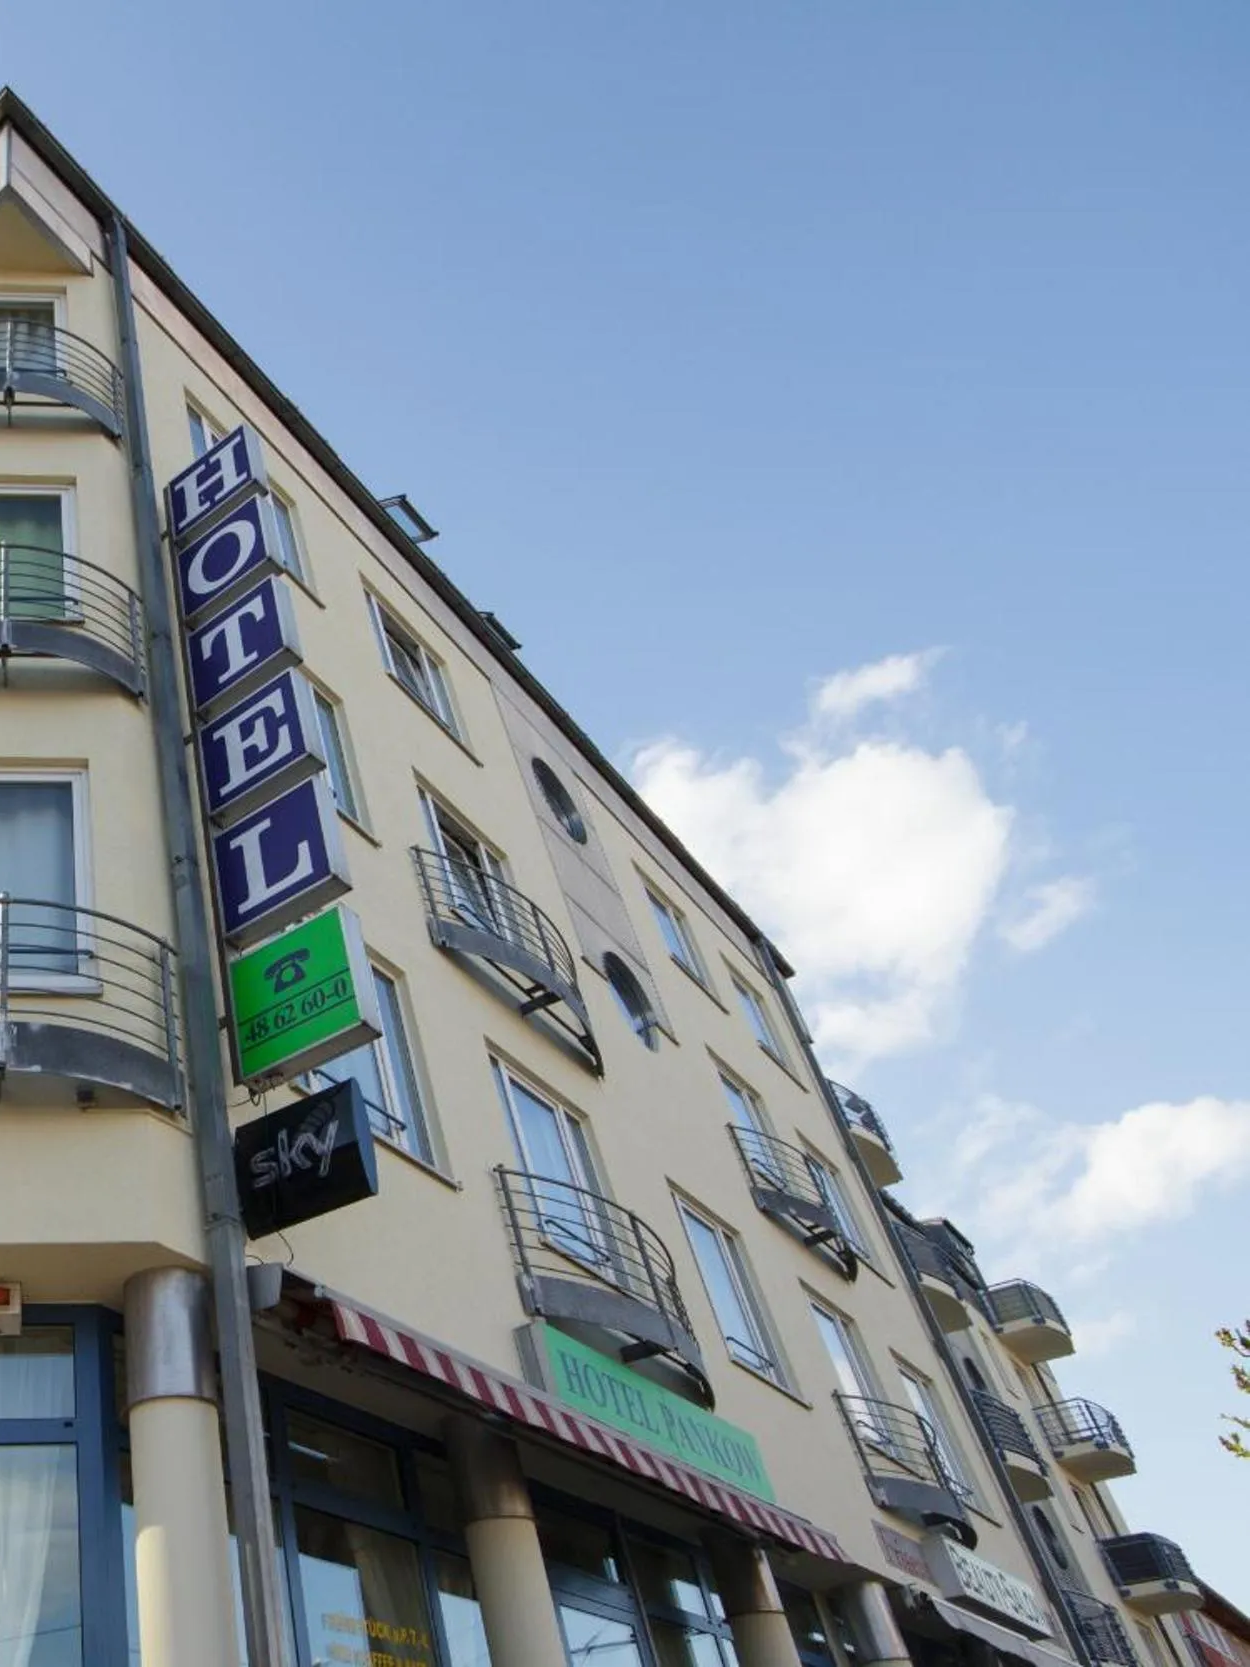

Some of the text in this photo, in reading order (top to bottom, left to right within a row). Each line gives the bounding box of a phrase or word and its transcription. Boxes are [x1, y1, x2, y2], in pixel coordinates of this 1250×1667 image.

[175, 436, 313, 914] HOTEL
[273, 1003, 298, 1030] 62
[300, 976, 348, 1017] 60-0
[250, 1119, 339, 1189] sky
[558, 1351, 762, 1481] HOTEL PANKOW
